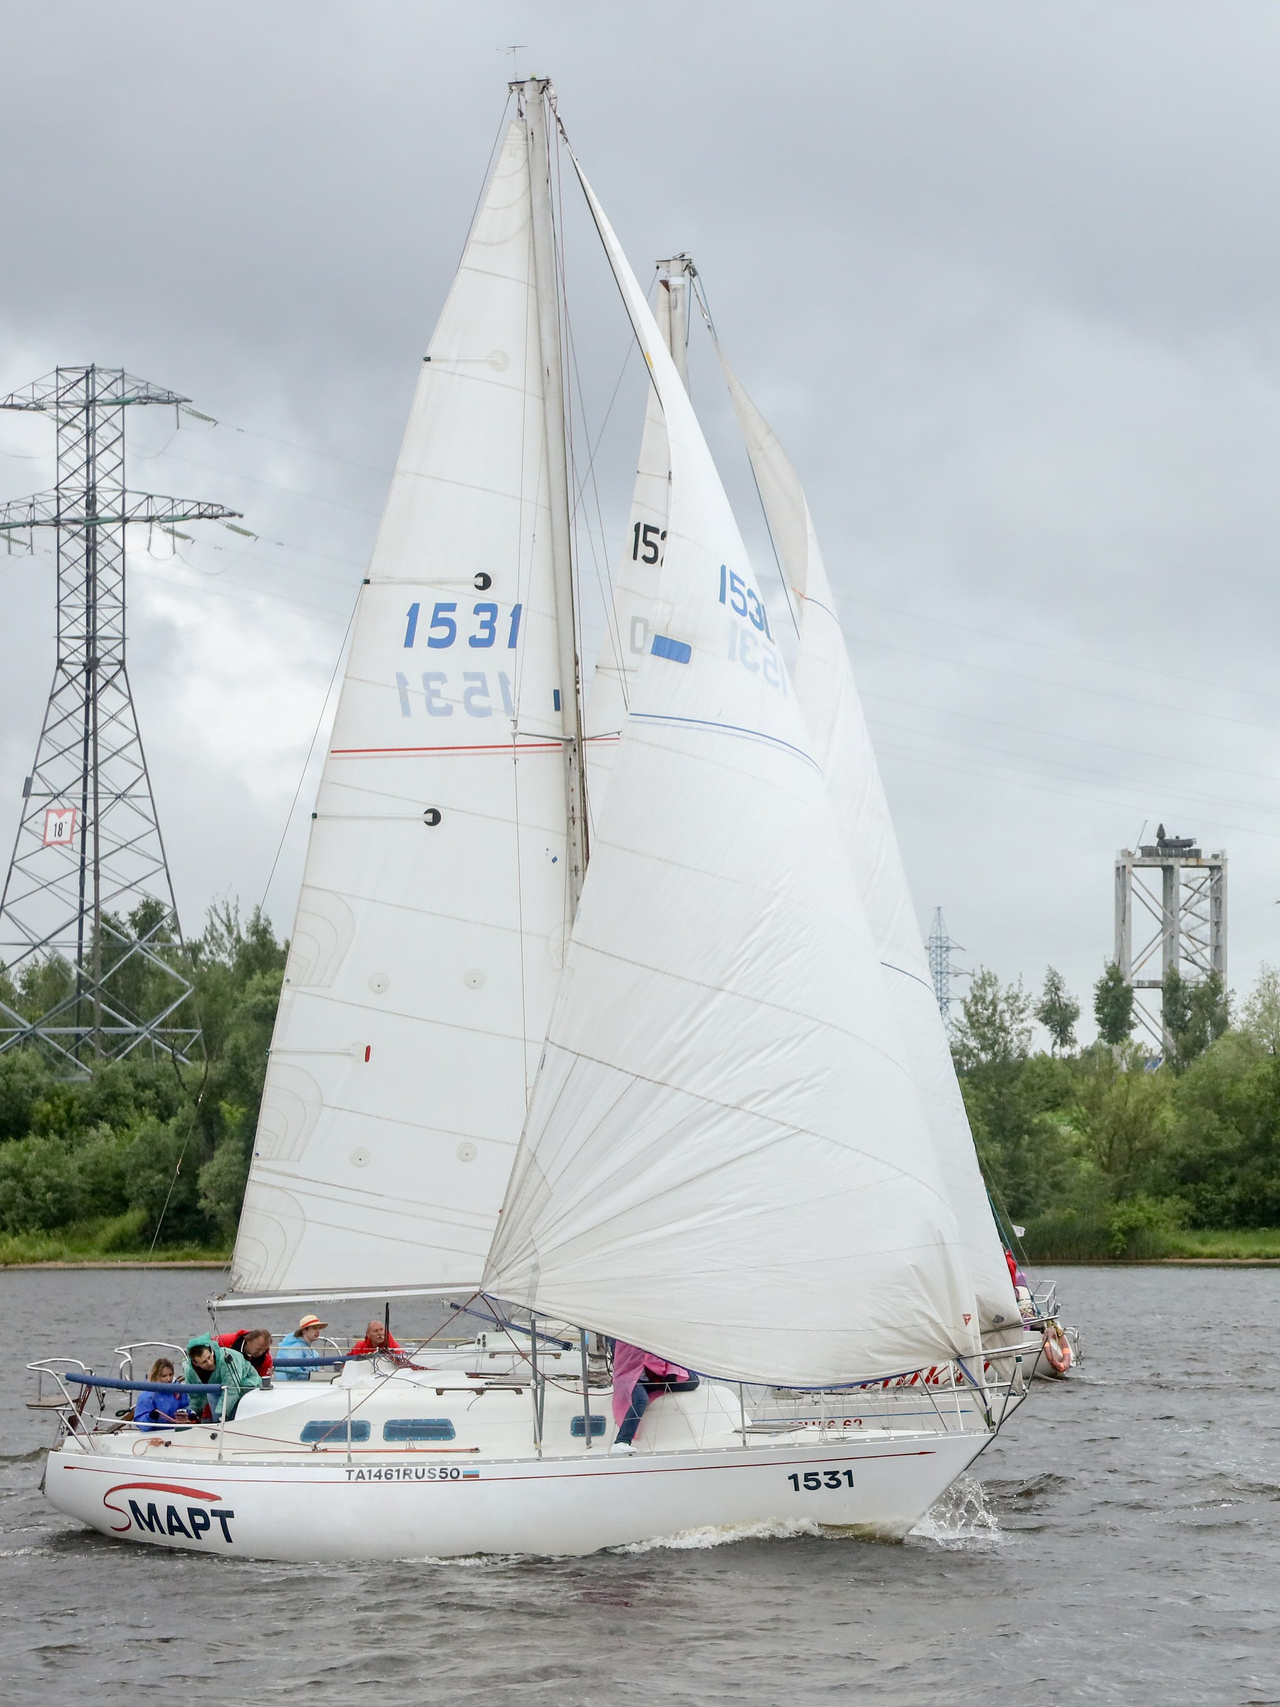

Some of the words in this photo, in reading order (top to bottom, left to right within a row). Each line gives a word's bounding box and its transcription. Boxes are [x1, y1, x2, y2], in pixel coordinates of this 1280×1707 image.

[404, 602, 523, 649] 1531
[54, 822, 64, 838] 18
[787, 1469, 855, 1492] 1531
